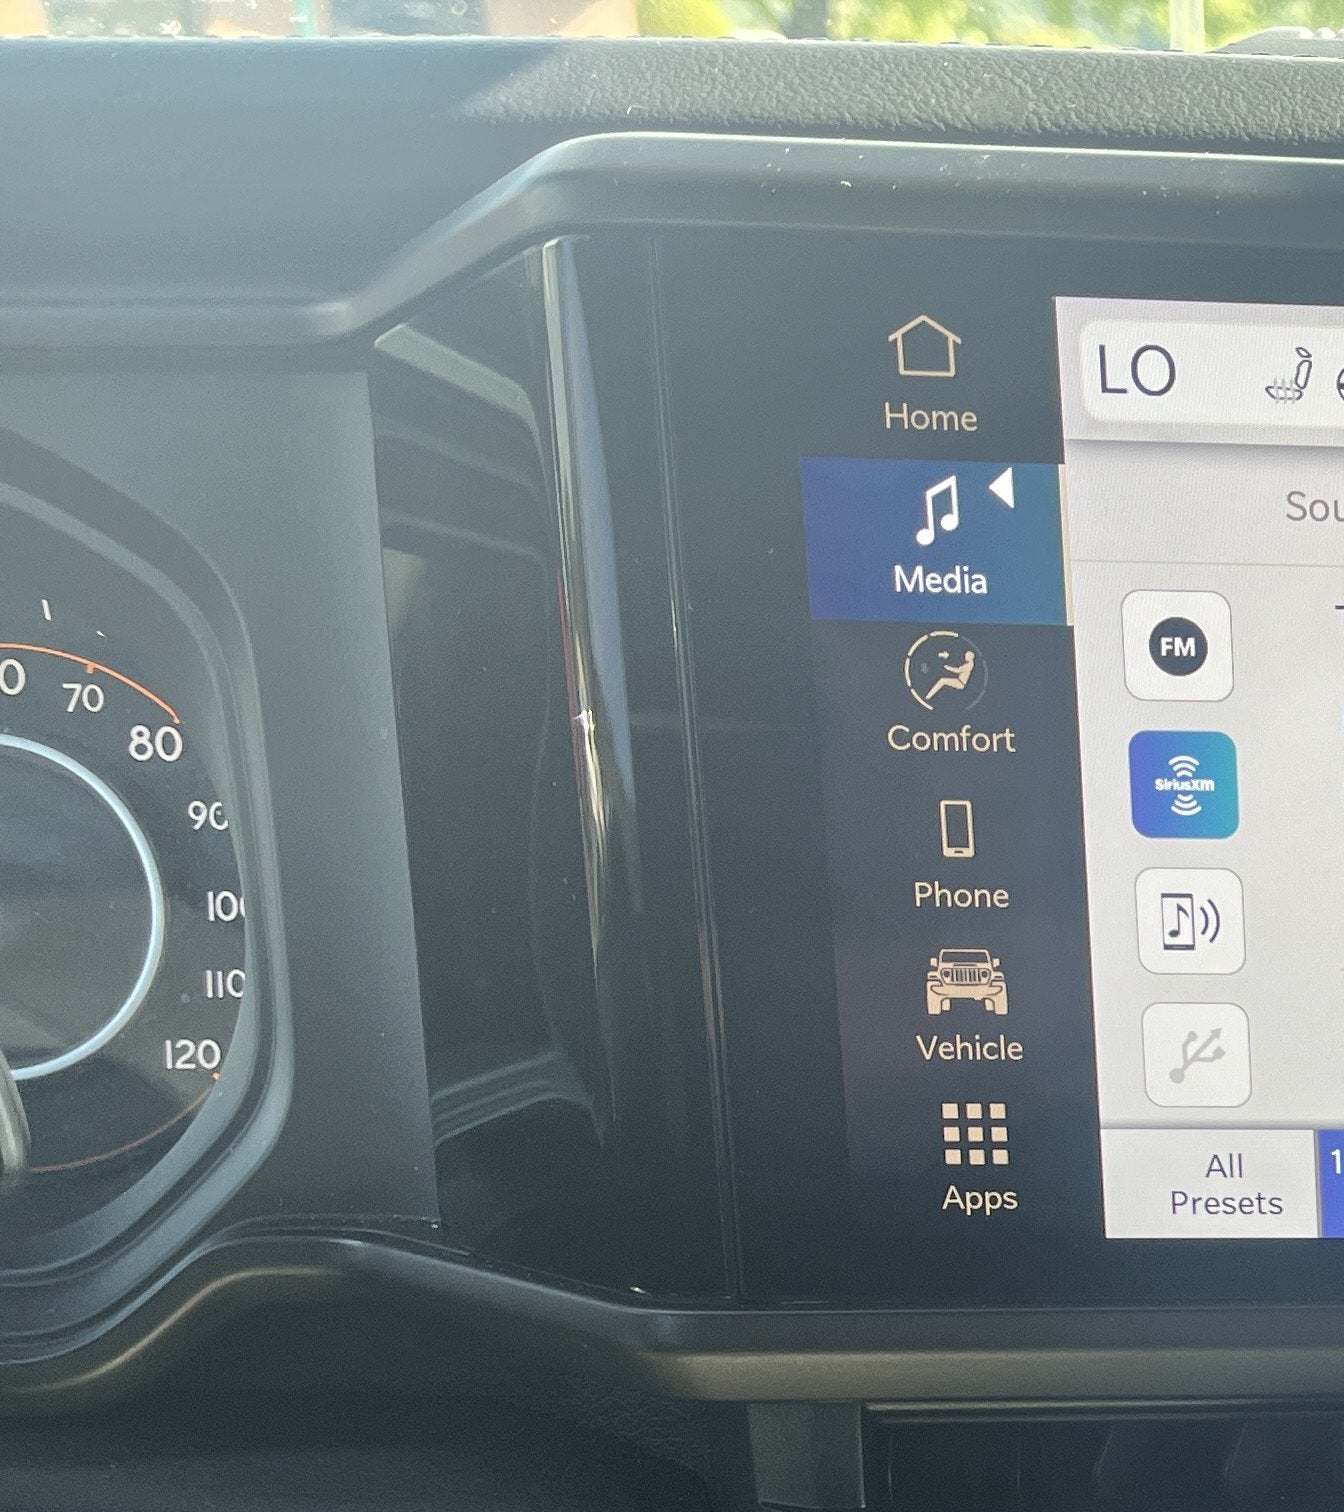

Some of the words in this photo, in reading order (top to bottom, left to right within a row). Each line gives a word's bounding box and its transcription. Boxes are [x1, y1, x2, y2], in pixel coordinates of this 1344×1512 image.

[1098, 344, 1176, 397] LO
[885, 402, 978, 432] Home
[894, 565, 988, 594] Media
[1160, 636, 1196, 657] FM
[62, 683, 105, 713] 70
[128, 724, 183, 762] 80
[887, 725, 1015, 754] Comfort
[207, 890, 246, 922] 10
[914, 881, 1010, 908] Phone
[164, 1038, 221, 1071] 120
[916, 1034, 1024, 1061] Vehicle
[1205, 1153, 1243, 1178] All
[1331, 1149, 1341, 1174] 1
[942, 1185, 1018, 1216] Apps
[1171, 1191, 1283, 1216] Presets
